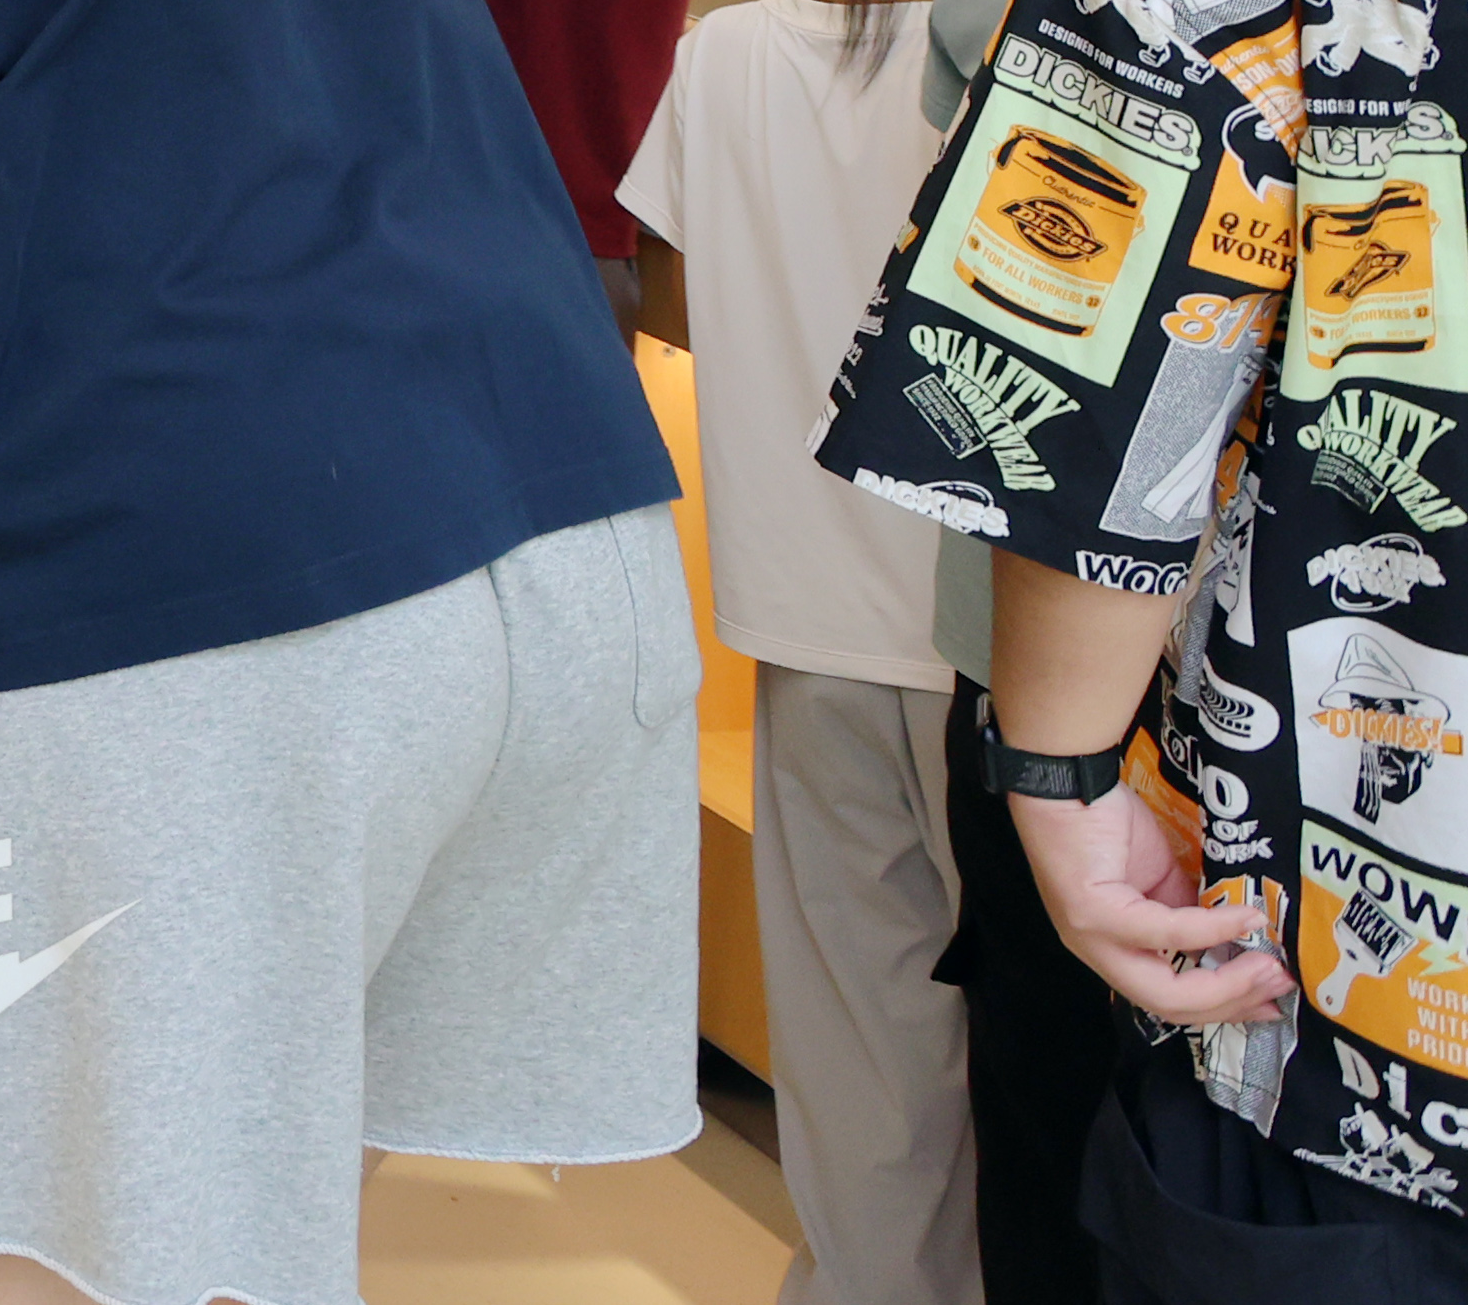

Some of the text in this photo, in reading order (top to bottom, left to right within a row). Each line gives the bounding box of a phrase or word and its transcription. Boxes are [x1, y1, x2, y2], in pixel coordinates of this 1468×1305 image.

[996, 34, 1195, 152] DICKIES
[1038, 18, 1185, 99] DESIGNED FOR WORKERS
[1359, 99, 1390, 117] FOR
[1011, 207, 1096, 253] Dickies
[981, 246, 1005, 270] FOR
[1004, 263, 1026, 283] ALL
[1028, 275, 1084, 306] WORKERS
[908, 323, 1082, 438] QUALITY
[945, 366, 1056, 491] WORKWEAR
[1324, 430, 1468, 532] WORKWEAR
[1203, 836, 1274, 866] ORK
